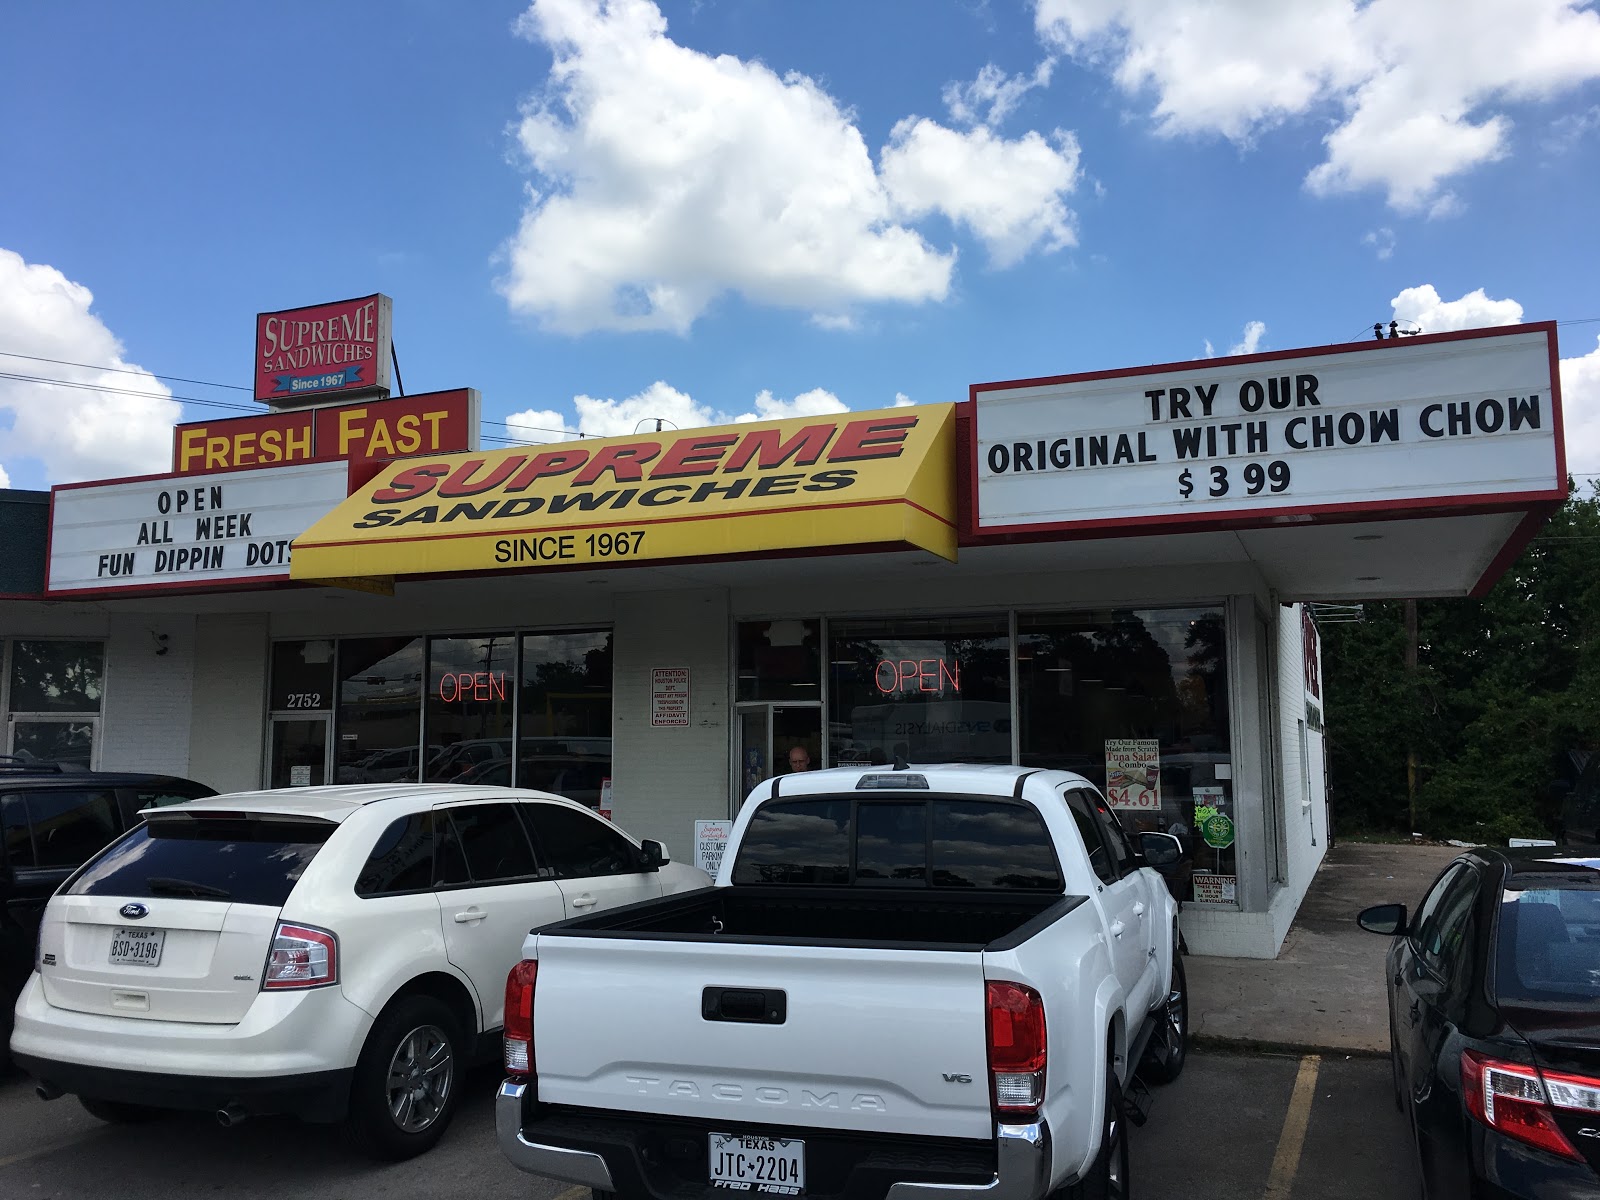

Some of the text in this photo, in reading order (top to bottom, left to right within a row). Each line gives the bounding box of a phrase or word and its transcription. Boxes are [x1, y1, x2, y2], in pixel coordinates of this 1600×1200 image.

[263, 301, 375, 358] SUPREME
[264, 343, 373, 373] SANDWICHES
[292, 375, 344, 390] Since 1967
[1145, 374, 1321, 421] TRY OUR
[180, 409, 448, 472] FRESH FAST
[988, 395, 1541, 474] ORIGINAL WITH CHOW CHOW
[372, 414, 919, 504] SUPREME
[157, 486, 223, 515] OPEN
[352, 469, 858, 529] SANDWICHES
[137, 513, 252, 546] ALL WEEK
[98, 551, 135, 577] FUN
[154, 545, 224, 573] DIPPIN
[494, 530, 645, 563] SINCE 1967
[439, 672, 505, 702] OPEN
[875, 658, 960, 693] OPEN
[287, 693, 320, 708] 2752
[1106, 752, 1158, 762] Tuna Salad
[1108, 788, 1160, 808] $4.61
[706, 862, 721, 870] ONLY
[1195, 876, 1236, 884] WARNING
[942, 1072, 972, 1084] V6
[626, 1076, 886, 1112] TACOMA
[738, 1139, 775, 1151] TEXAS
[757, 1184, 800, 1195] Haas
